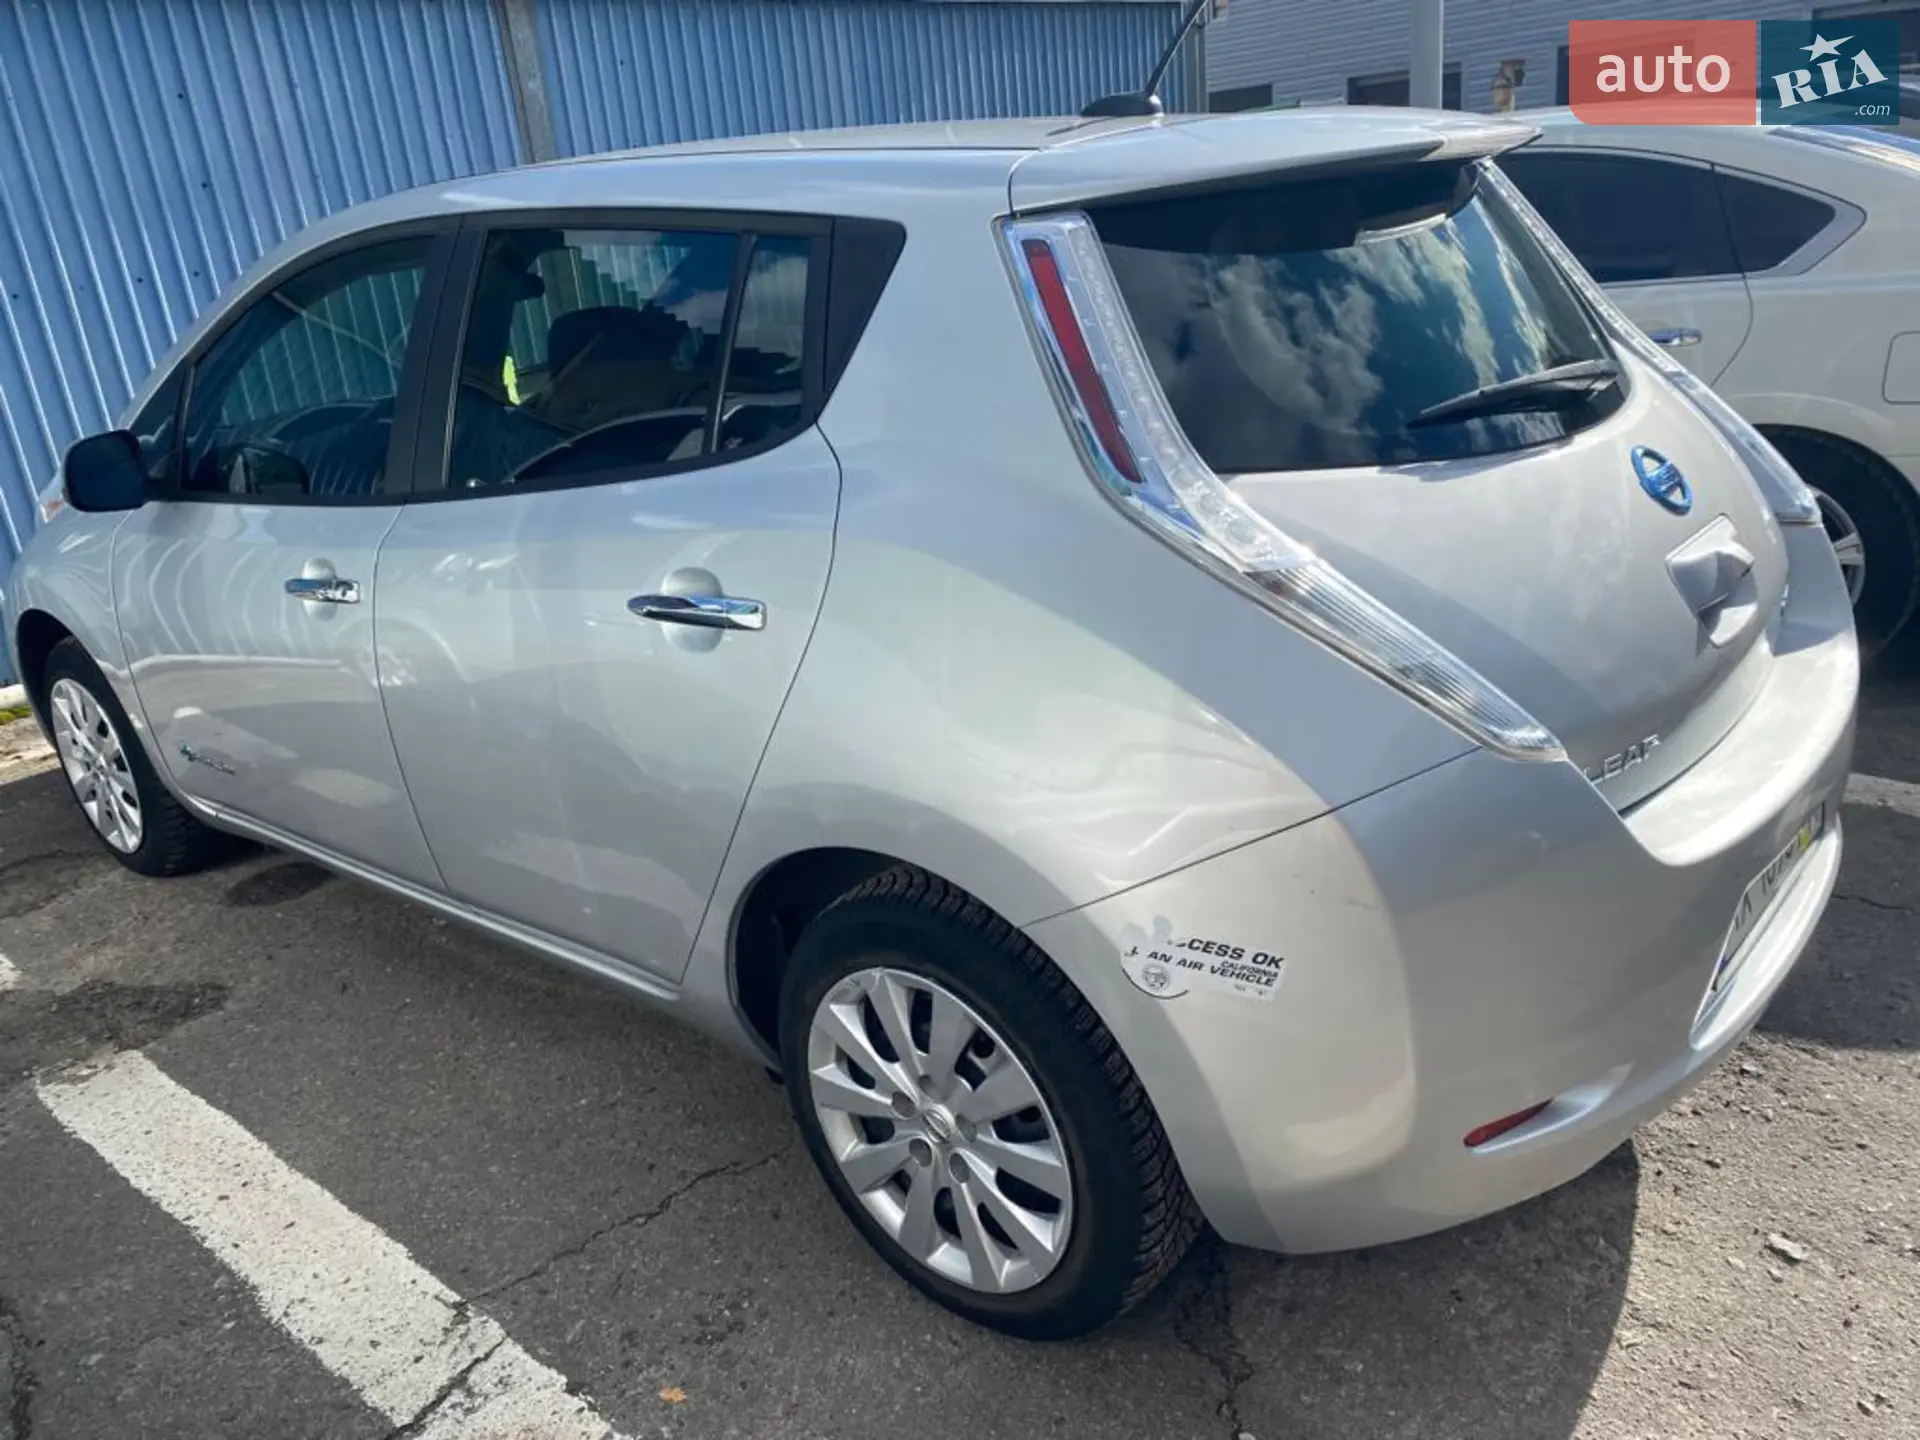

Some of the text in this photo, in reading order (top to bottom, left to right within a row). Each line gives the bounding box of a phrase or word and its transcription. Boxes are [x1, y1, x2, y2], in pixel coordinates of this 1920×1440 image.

[1167, 938, 1285, 970] CESS OK
[1176, 957, 1204, 972] AIR
[1210, 965, 1277, 987] VEHICLE
[1220, 960, 1279, 979] CALIFORNIA
